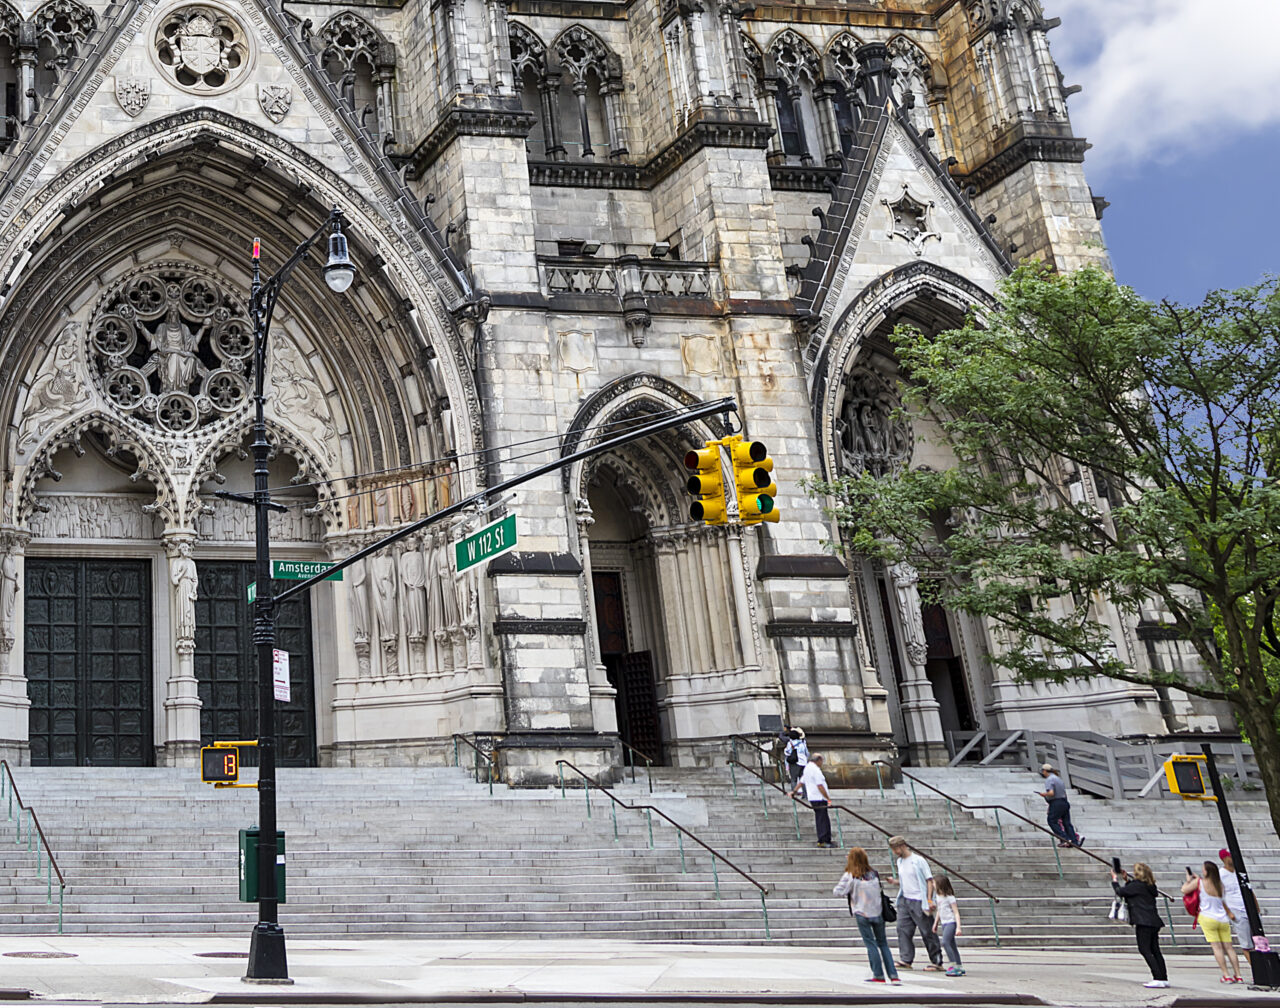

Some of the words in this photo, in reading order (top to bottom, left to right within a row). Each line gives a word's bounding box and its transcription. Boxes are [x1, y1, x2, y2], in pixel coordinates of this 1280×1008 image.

[467, 540, 476, 561] W
[479, 532, 492, 556] 112
[495, 525, 504, 548] St
[224, 754, 236, 775] 13
